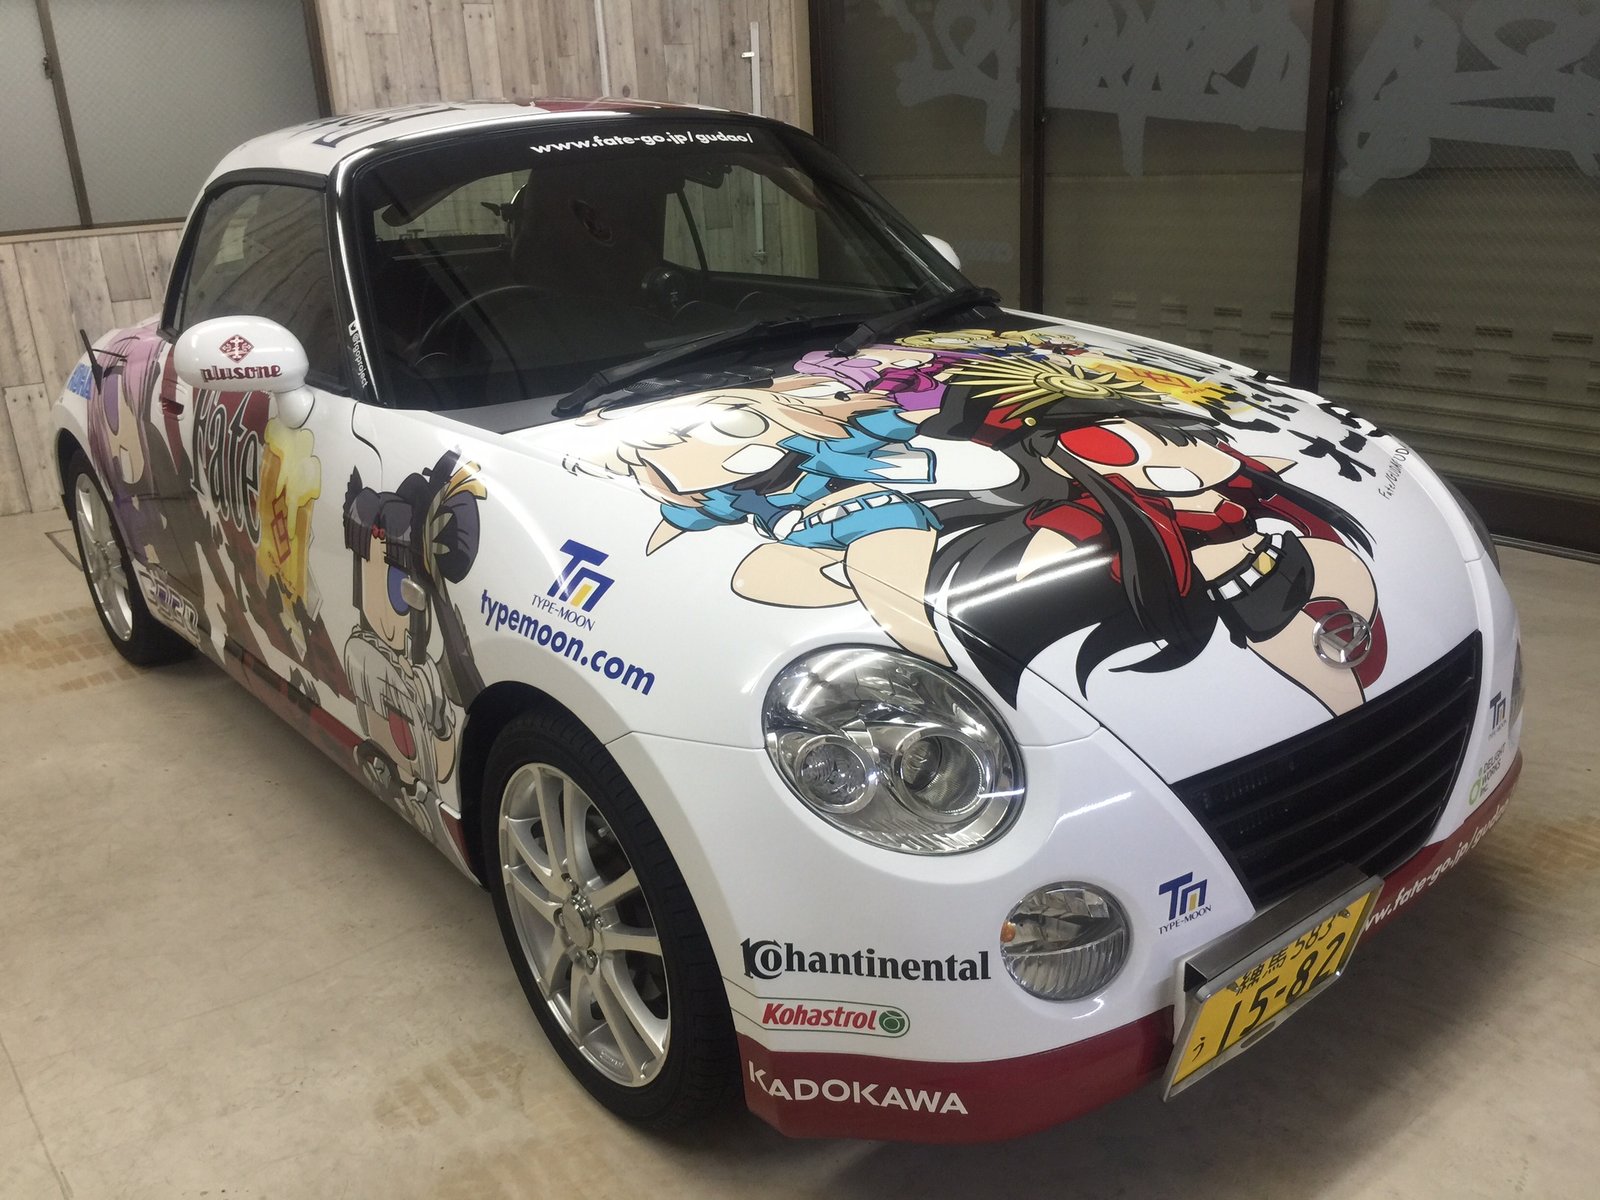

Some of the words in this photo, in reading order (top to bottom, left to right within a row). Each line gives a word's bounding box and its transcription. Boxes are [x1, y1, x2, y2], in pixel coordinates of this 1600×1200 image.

[530, 131, 754, 154] www.fate-go.jp/gudao/
[200, 364, 282, 382] plusone
[531, 594, 596, 632] TYPE-MOON
[481, 589, 656, 696] typemoon.com
[1159, 904, 1213, 935] TYPE-MOON
[1290, 914, 1338, 960] 583
[1216, 932, 1346, 1055] 15-82
[762, 1003, 877, 1031] Kohastrol
[748, 1060, 969, 1115] KADOKAWA
